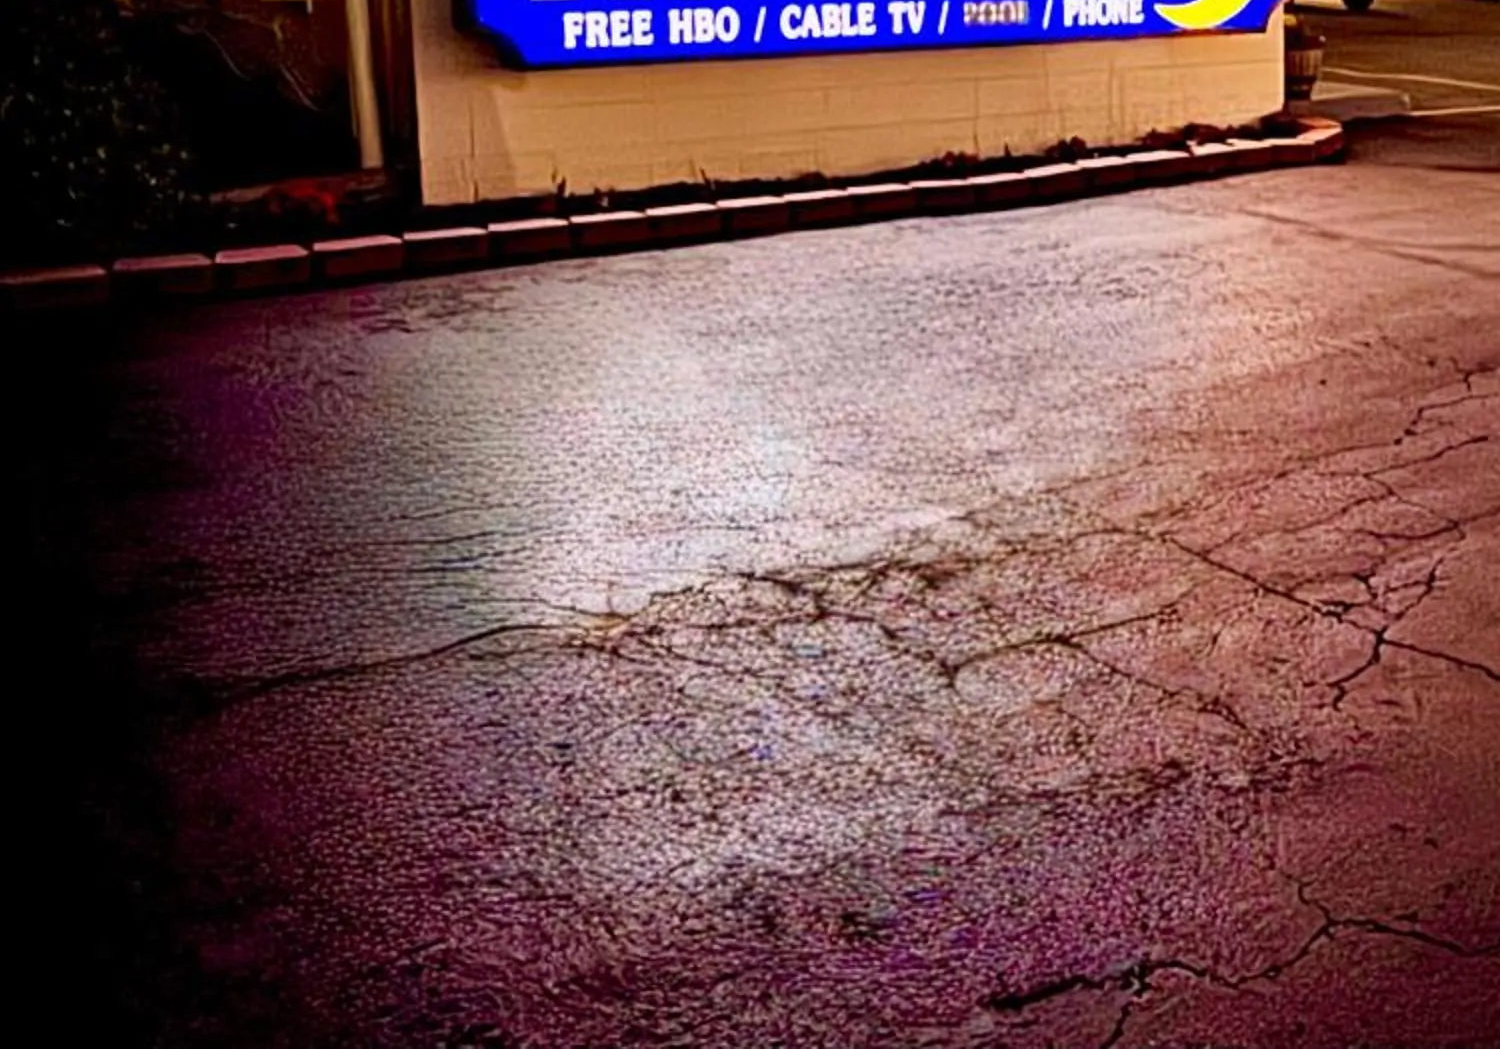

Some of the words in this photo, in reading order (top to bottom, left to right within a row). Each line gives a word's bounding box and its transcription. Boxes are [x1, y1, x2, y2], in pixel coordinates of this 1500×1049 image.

[562, 9, 655, 50] FREE
[667, 6, 741, 45] HBO
[779, 2, 877, 40] CABLE
[887, 0, 926, 35] TV
